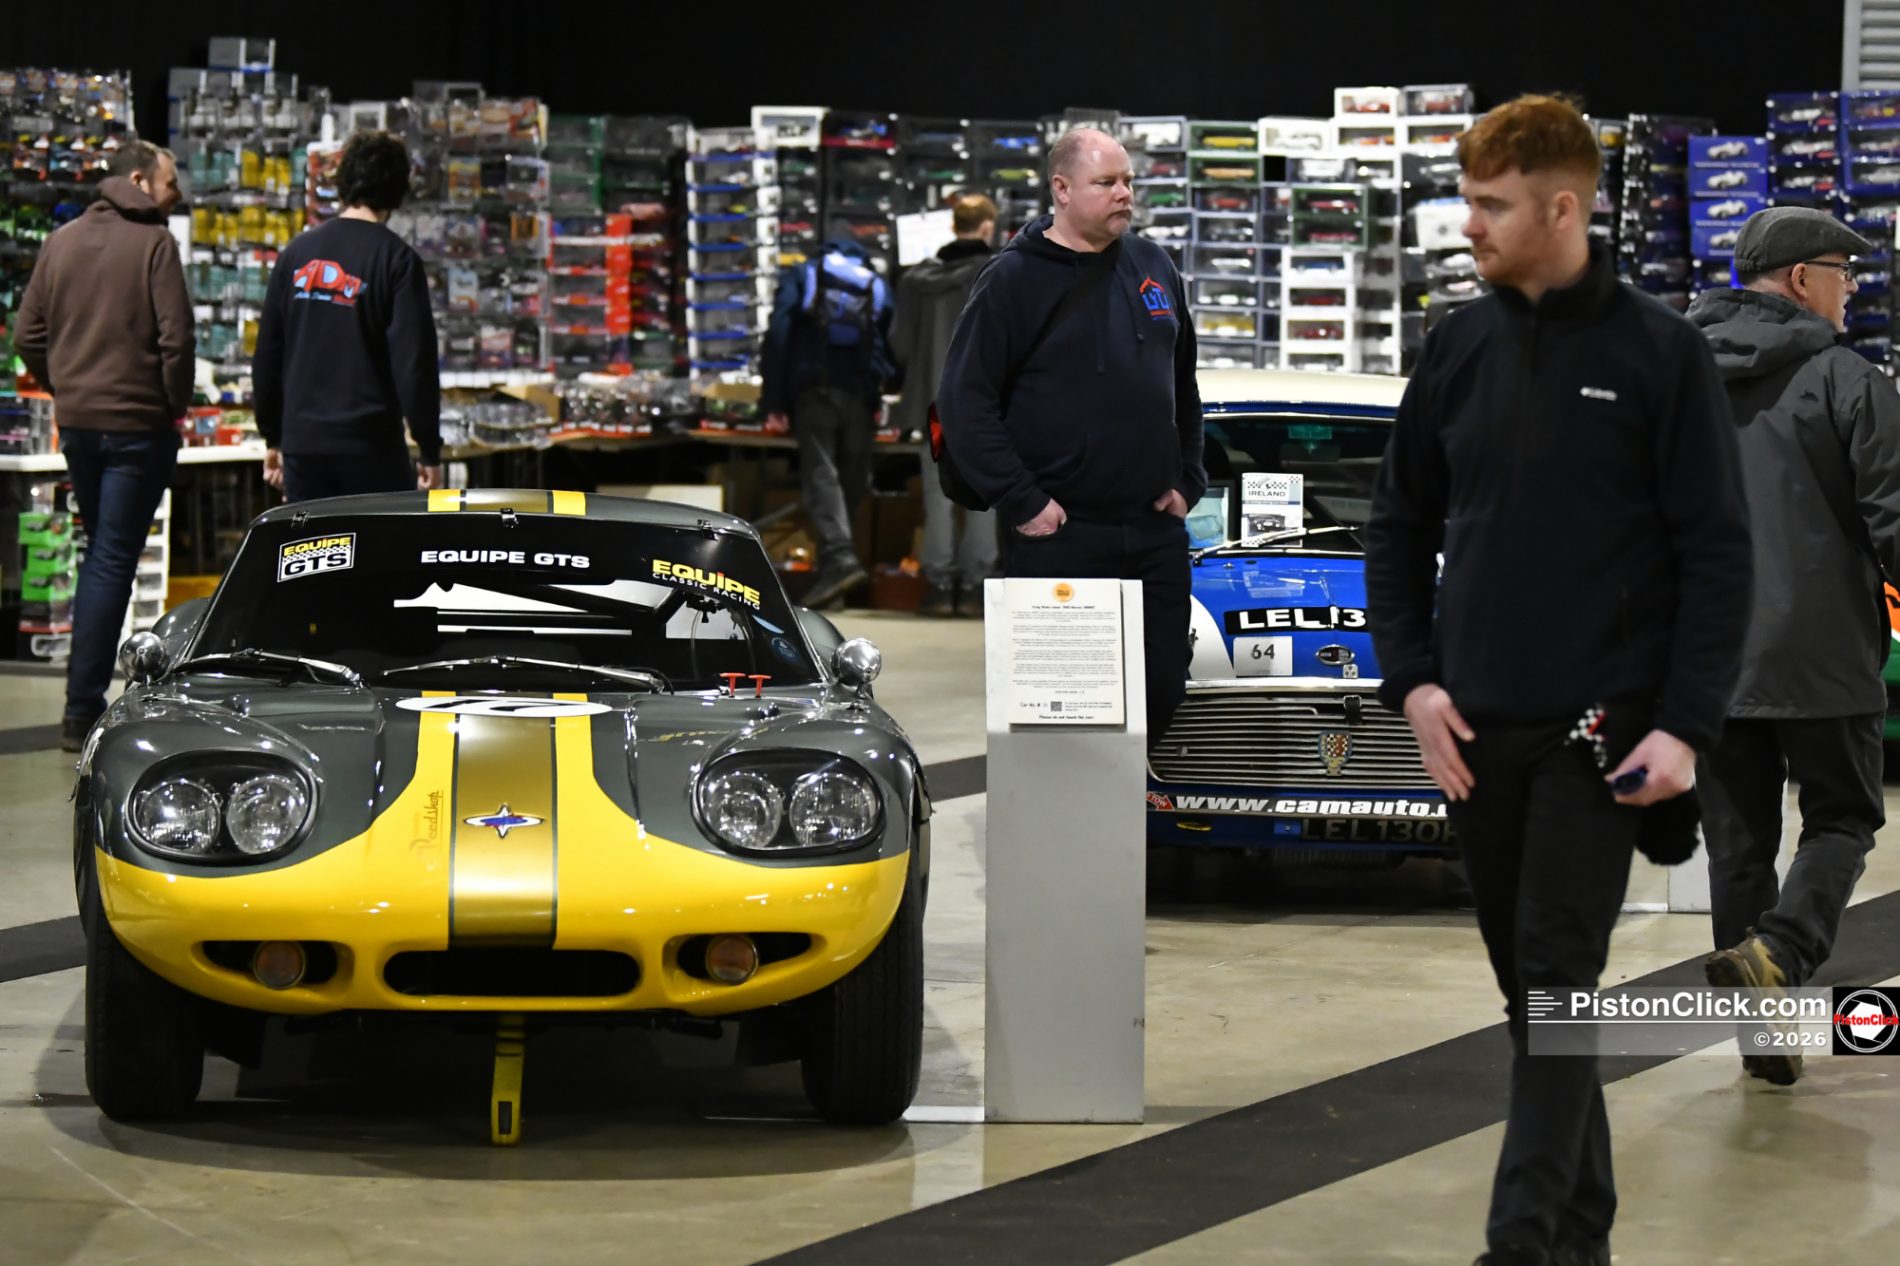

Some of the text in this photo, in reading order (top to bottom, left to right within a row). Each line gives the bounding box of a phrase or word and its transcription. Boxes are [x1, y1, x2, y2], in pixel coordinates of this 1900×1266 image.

[284, 553, 347, 576] GTS
[421, 550, 590, 569] EQUIPE GTS
[652, 572, 761, 611] CLASSIC RACING
[1251, 643, 1275, 660] 64
